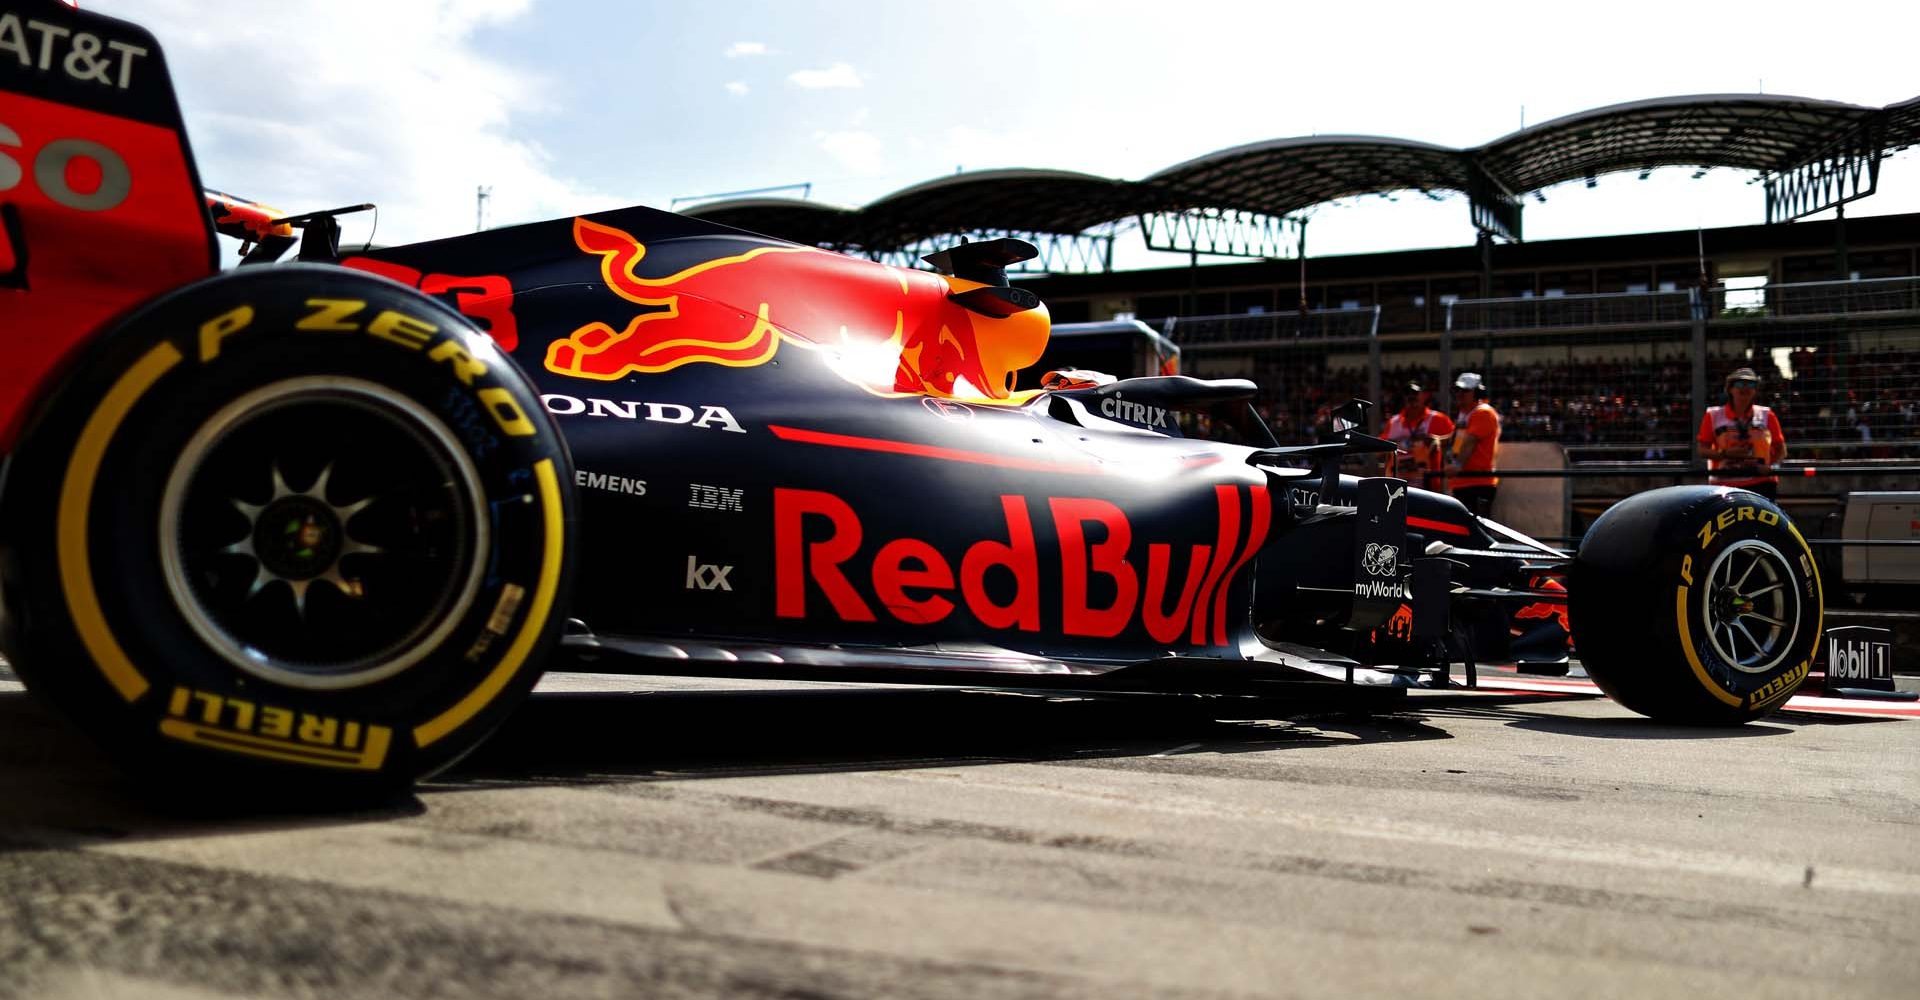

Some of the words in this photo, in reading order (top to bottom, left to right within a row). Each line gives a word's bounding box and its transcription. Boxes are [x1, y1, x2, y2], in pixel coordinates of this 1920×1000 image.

[0, 12, 148, 89] AT&T
[0, 122, 131, 212] O
[340, 257, 519, 359] 3
[199, 305, 254, 363] P
[295, 298, 537, 437] ZERO
[541, 393, 747, 434] ONDA
[575, 470, 647, 496] EMENS
[688, 484, 744, 512] IBM
[1680, 553, 1694, 586] P
[1697, 506, 1779, 550] ZERO
[685, 555, 734, 592] kx
[1355, 580, 1403, 599] myWorld
[1829, 637, 1869, 679] Mobil
[1876, 645, 1885, 678] 1
[1749, 660, 1808, 711] PIRELLI
[159, 685, 392, 771] PIRELLI
